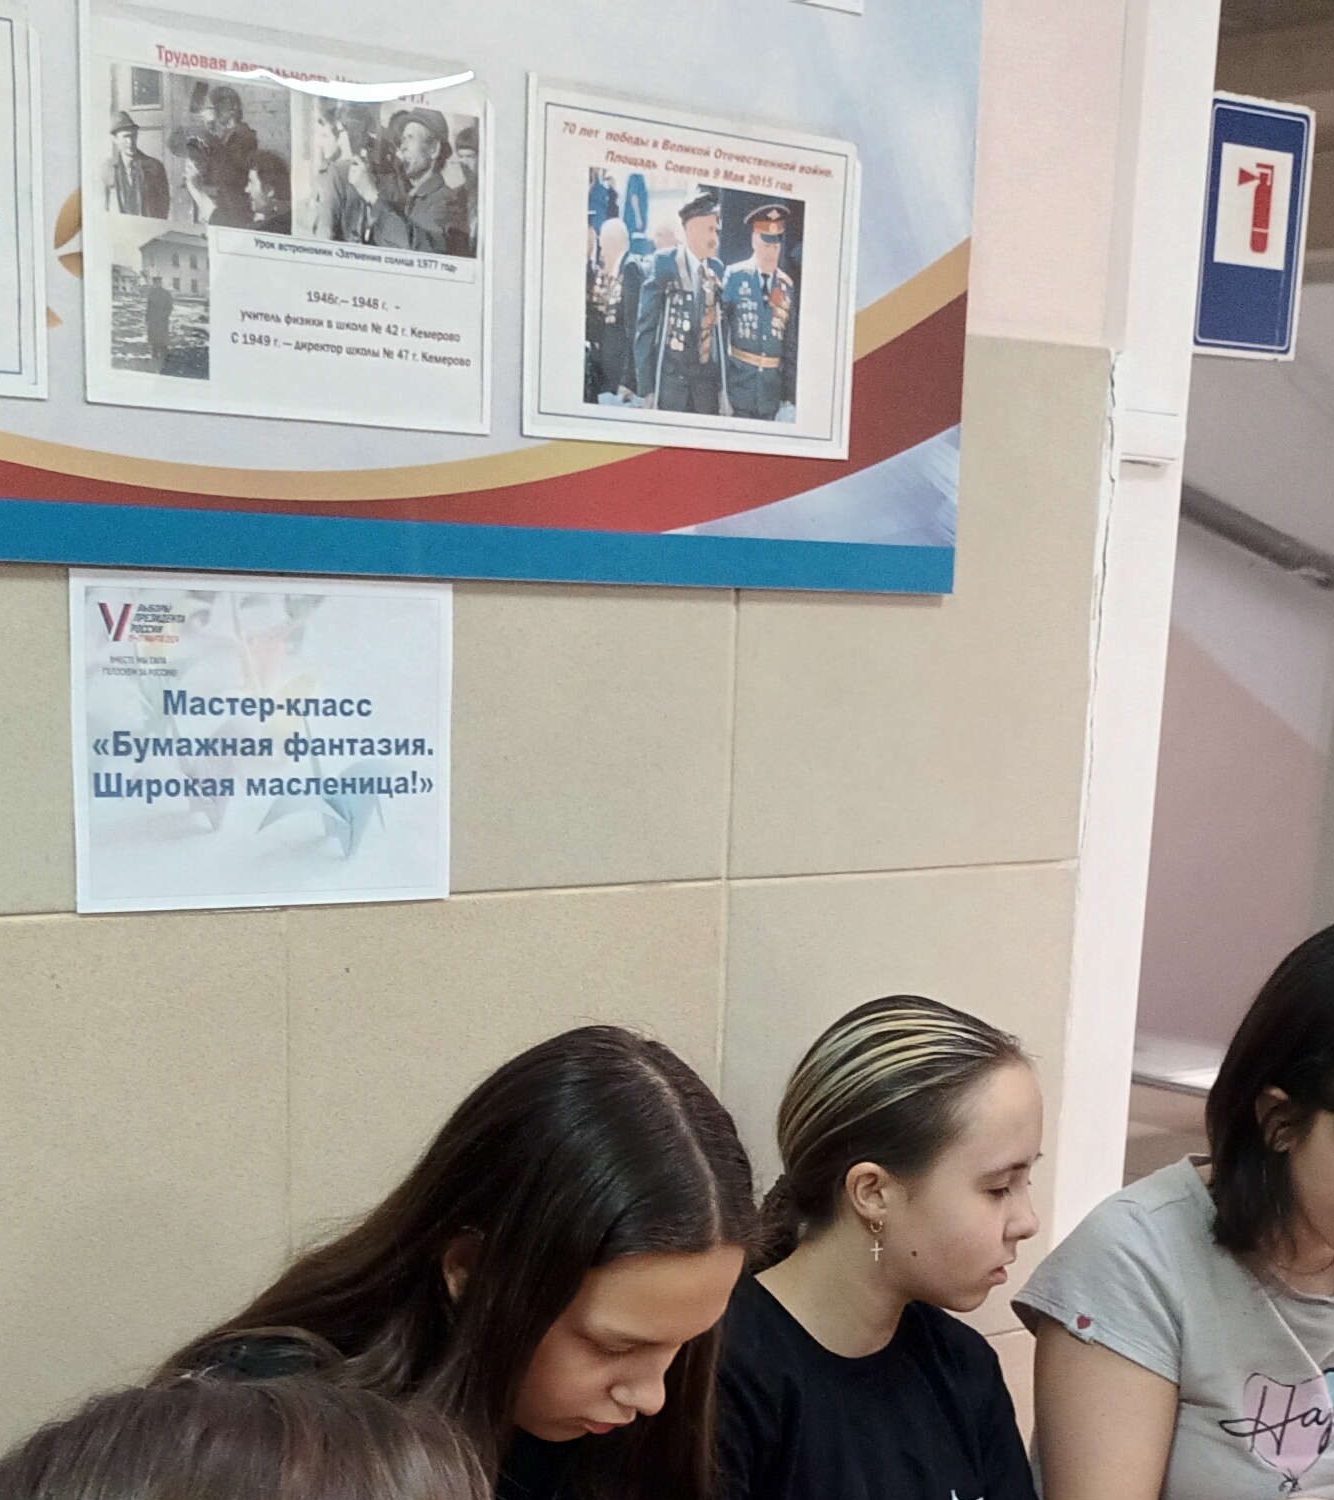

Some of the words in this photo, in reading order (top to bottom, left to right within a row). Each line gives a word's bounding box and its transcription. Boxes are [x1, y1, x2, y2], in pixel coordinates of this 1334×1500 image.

[155, 44, 228, 72] Трудовая
[562, 121, 578, 134] 70
[578, 127, 601, 139] лет
[605, 131, 649, 148] победы
[651, 140, 659, 148] в
[661, 138, 711, 157] Великой
[713, 148, 796, 173] Отечественной
[605, 150, 658, 170] Площадь
[664, 160, 710, 178] Советов
[712, 168, 721, 179] 9
[722, 169, 746, 183] Мая
[747, 174, 774, 189] 2015
[254, 237, 276, 249] Урок
[277, 242, 333, 256] астрономии
[384, 256, 415, 267] солнца
[417, 258, 439, 270] 1977
[352, 296, 379, 310] 1948
[240, 309, 282, 323] учитель
[284, 314, 324, 327] физики
[327, 320, 334, 328] в
[336, 321, 369, 332] школе
[371, 322, 383, 334] №
[385, 324, 399, 336] 42
[410, 327, 461, 342] Кемерово
[231, 332, 239, 343] С
[242, 333, 271, 346] 1949
[294, 341, 343, 356] директор
[346, 346, 380, 357] школы
[382, 347, 394, 359] №
[397, 349, 410, 360] 47
[421, 351, 472, 367] Кемерово
[163, 690, 372, 723] Мастер-класс
[92, 730, 273, 763] «Бумажная
[283, 731, 434, 763] фантазия.
[93, 772, 235, 804] Широкая
[246, 770, 434, 799] масленица!»
